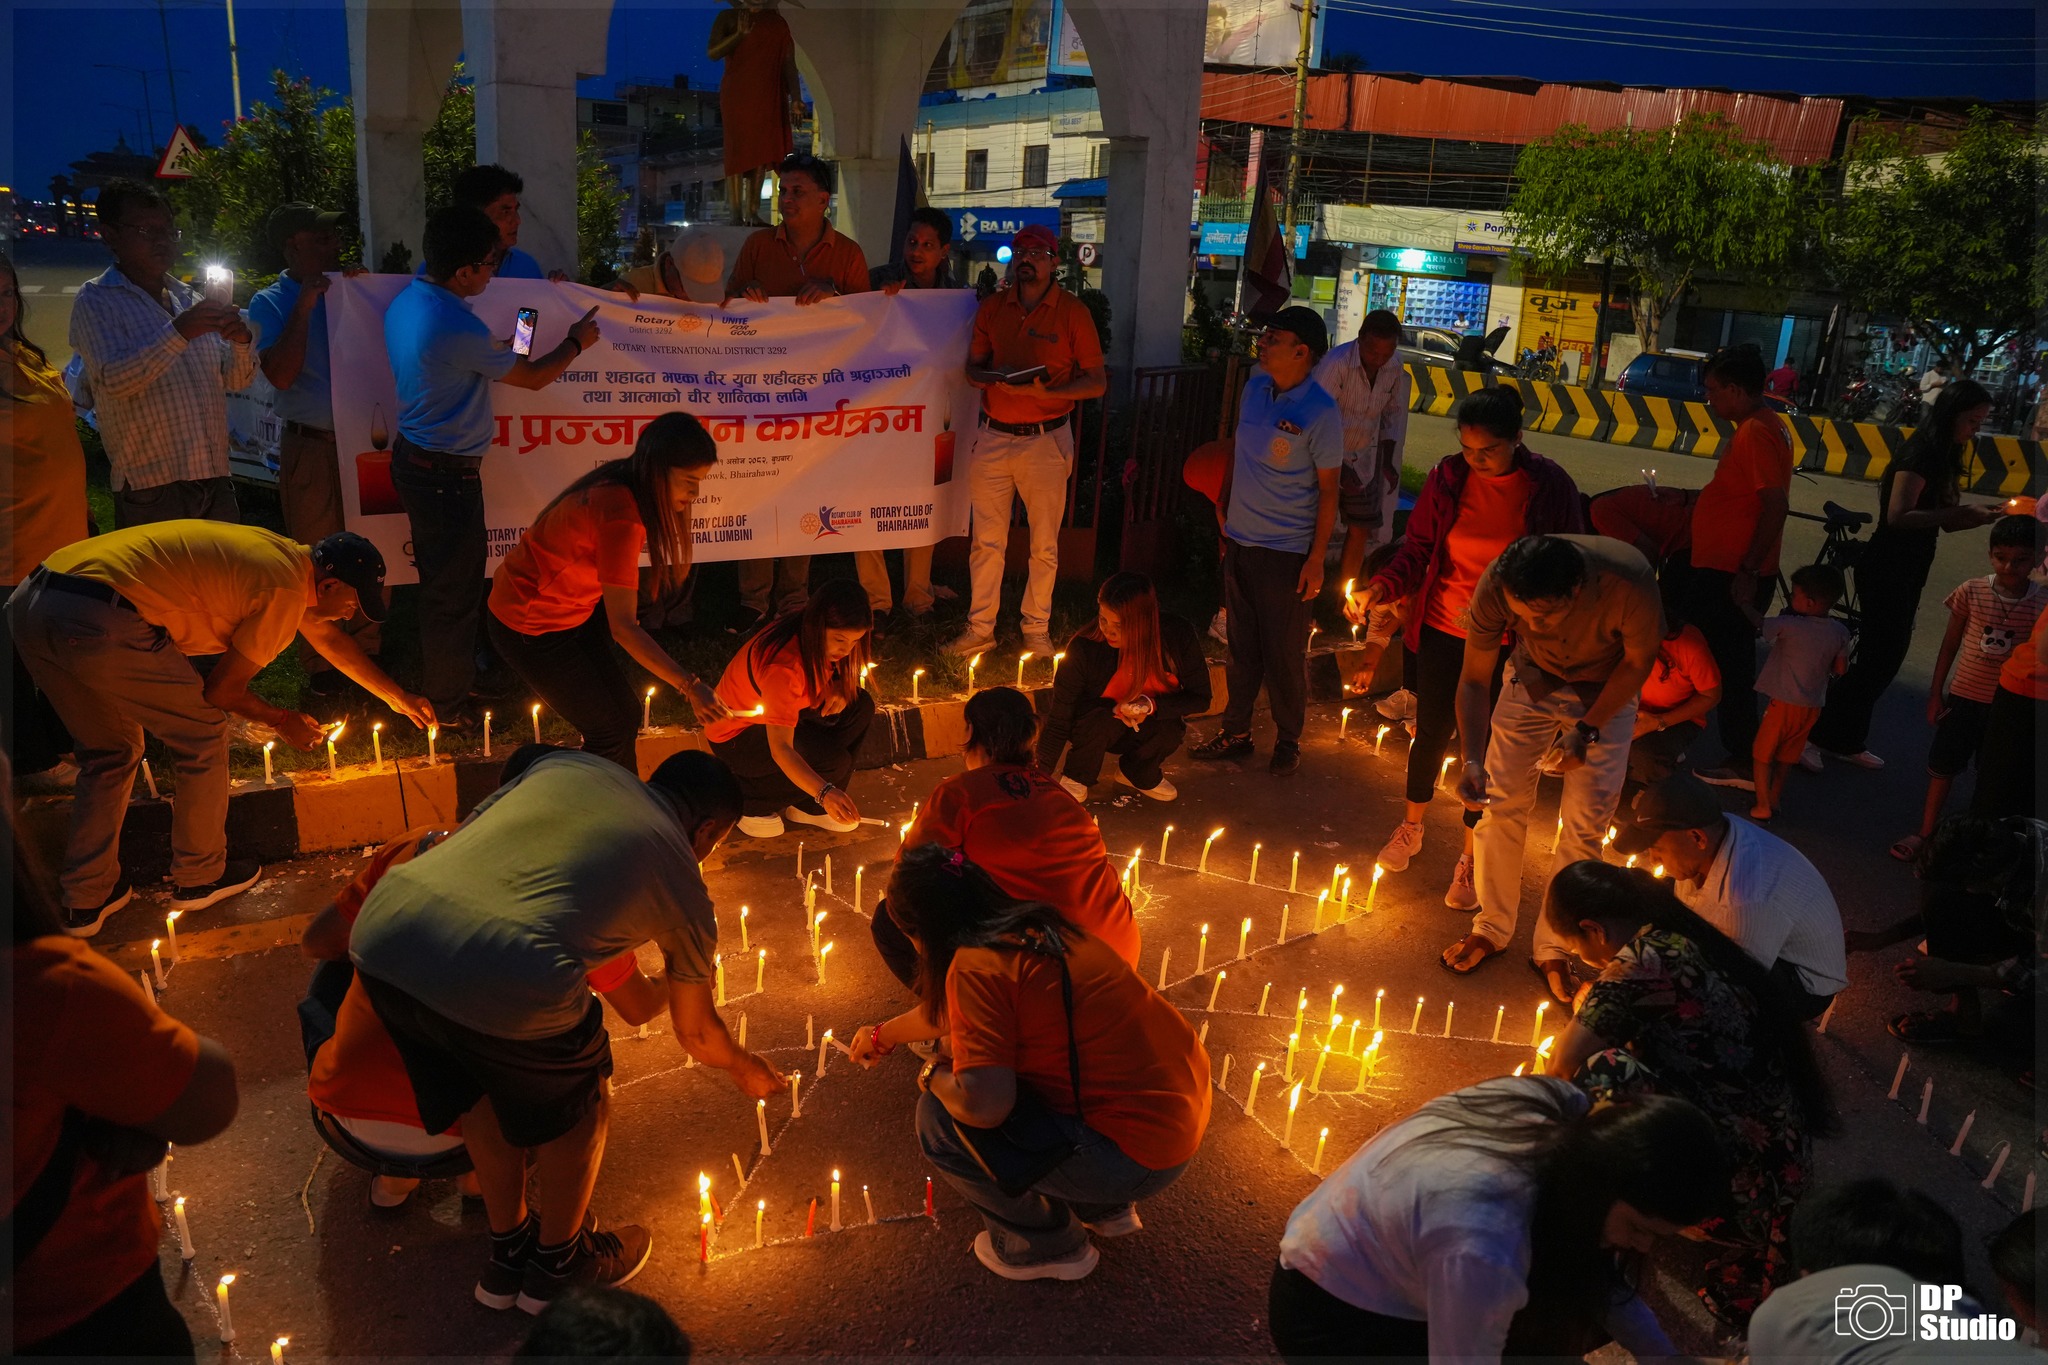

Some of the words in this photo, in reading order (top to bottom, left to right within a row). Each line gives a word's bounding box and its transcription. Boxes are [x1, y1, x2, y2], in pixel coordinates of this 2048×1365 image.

[980, 220, 1024, 234] BAJAJ
[635, 315, 675, 326] Rotary
[722, 316, 748, 325] UNITE
[629, 326, 653, 334] District
[612, 343, 647, 353] ROTARY
[651, 345, 722, 355] INTERNATIONAL
[724, 347, 765, 355] DISTRICT
[767, 347, 787, 355] 3292
[605, 371, 656, 384] शहादत
[662, 371, 699, 385] भएका
[704, 370, 726, 386] वीर
[733, 373, 757, 388] युवा
[822, 369, 845, 385] प्रति
[583, 390, 612, 403] तथा
[619, 388, 681, 403] आत्माको
[688, 388, 711, 404] चीर
[717, 388, 770, 404] शान्तिका
[776, 388, 808, 404] लागि
[753, 399, 926, 443] कार्यक्रम
[726, 457, 746, 465] असोज
[730, 468, 780, 479] Bhairahawa)
[711, 495, 722, 505] by
[870, 506, 902, 519] ROTARY
[903, 505, 923, 517] CLUB
[925, 504, 933, 515] OF
[712, 516, 734, 529] CLUB
[736, 514, 747, 527] OF
[831, 518, 862, 526] BHAIRAHAWA
[877, 518, 929, 532] BHAIRAHAWA
[486, 528, 517, 542] OTARY
[715, 529, 752, 543] LUMBINI
